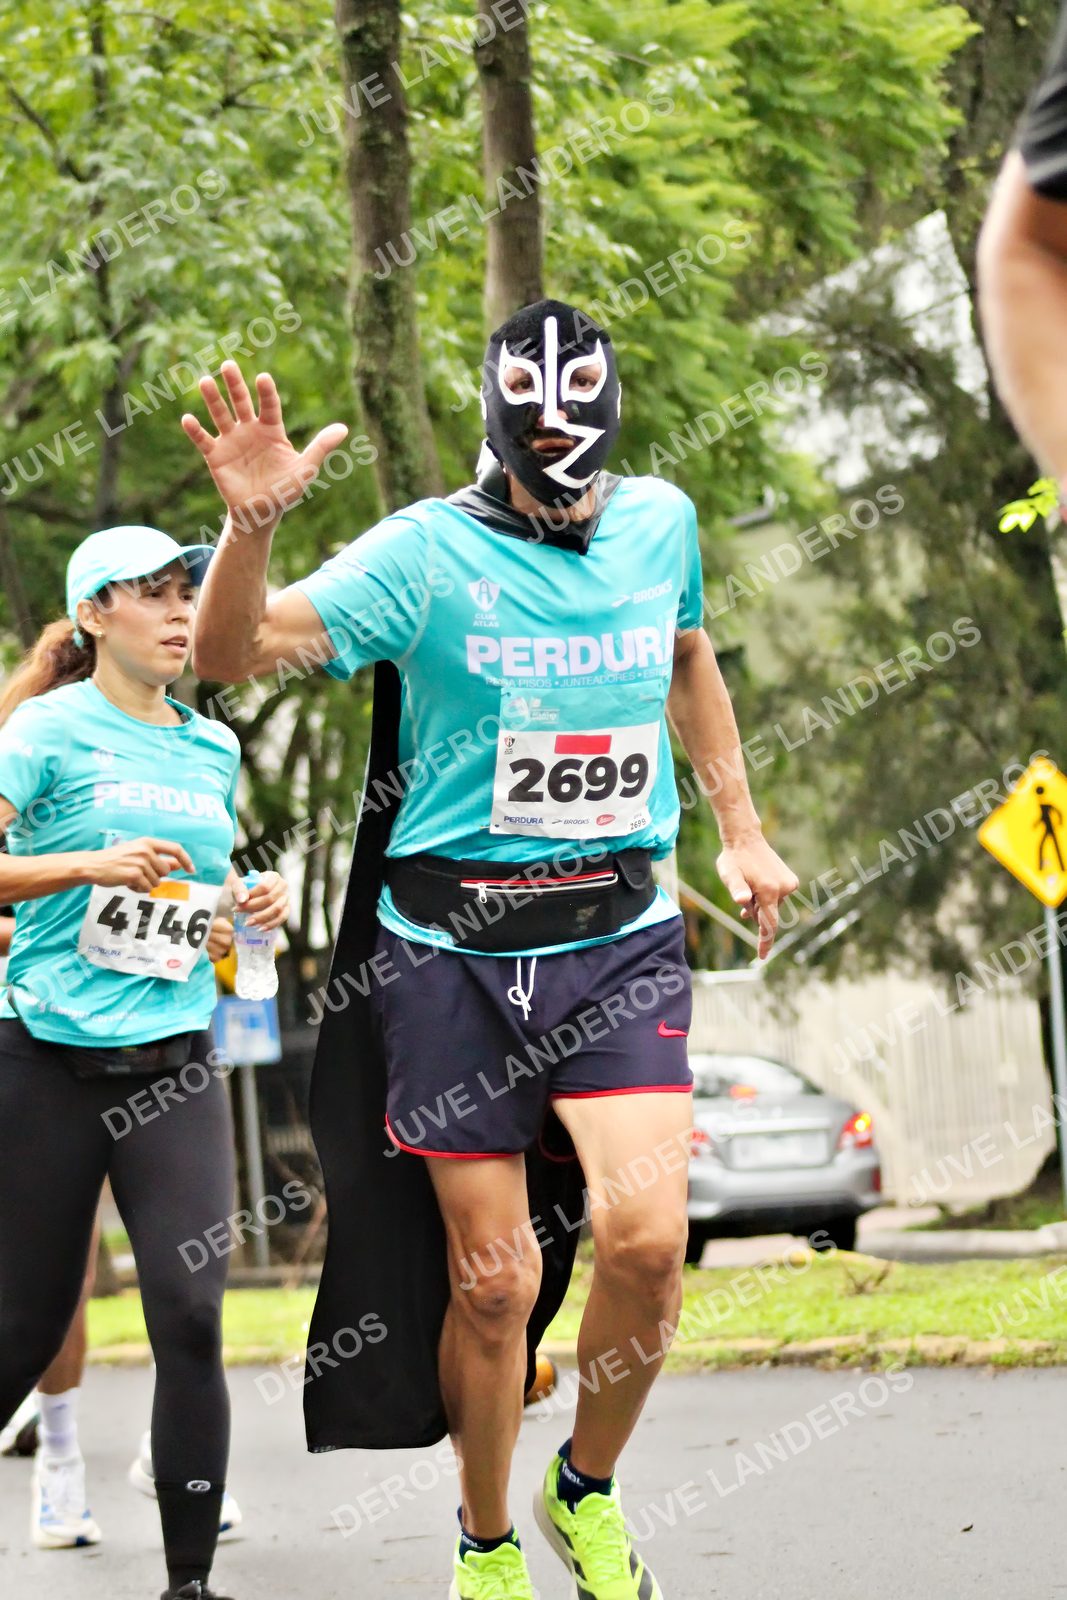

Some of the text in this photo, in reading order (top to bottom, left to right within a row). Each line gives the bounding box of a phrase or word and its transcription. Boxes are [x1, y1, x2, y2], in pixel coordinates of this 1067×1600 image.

[632, 579, 672, 604] BROOKS
[473, 620, 499, 628] ATLAS
[518, 679, 552, 688] PISOS
[560, 671, 635, 687] JUNTEADORES
[508, 753, 648, 803] 2699
[503, 815, 544, 825] PERDURA
[97, 895, 212, 949] 4146
